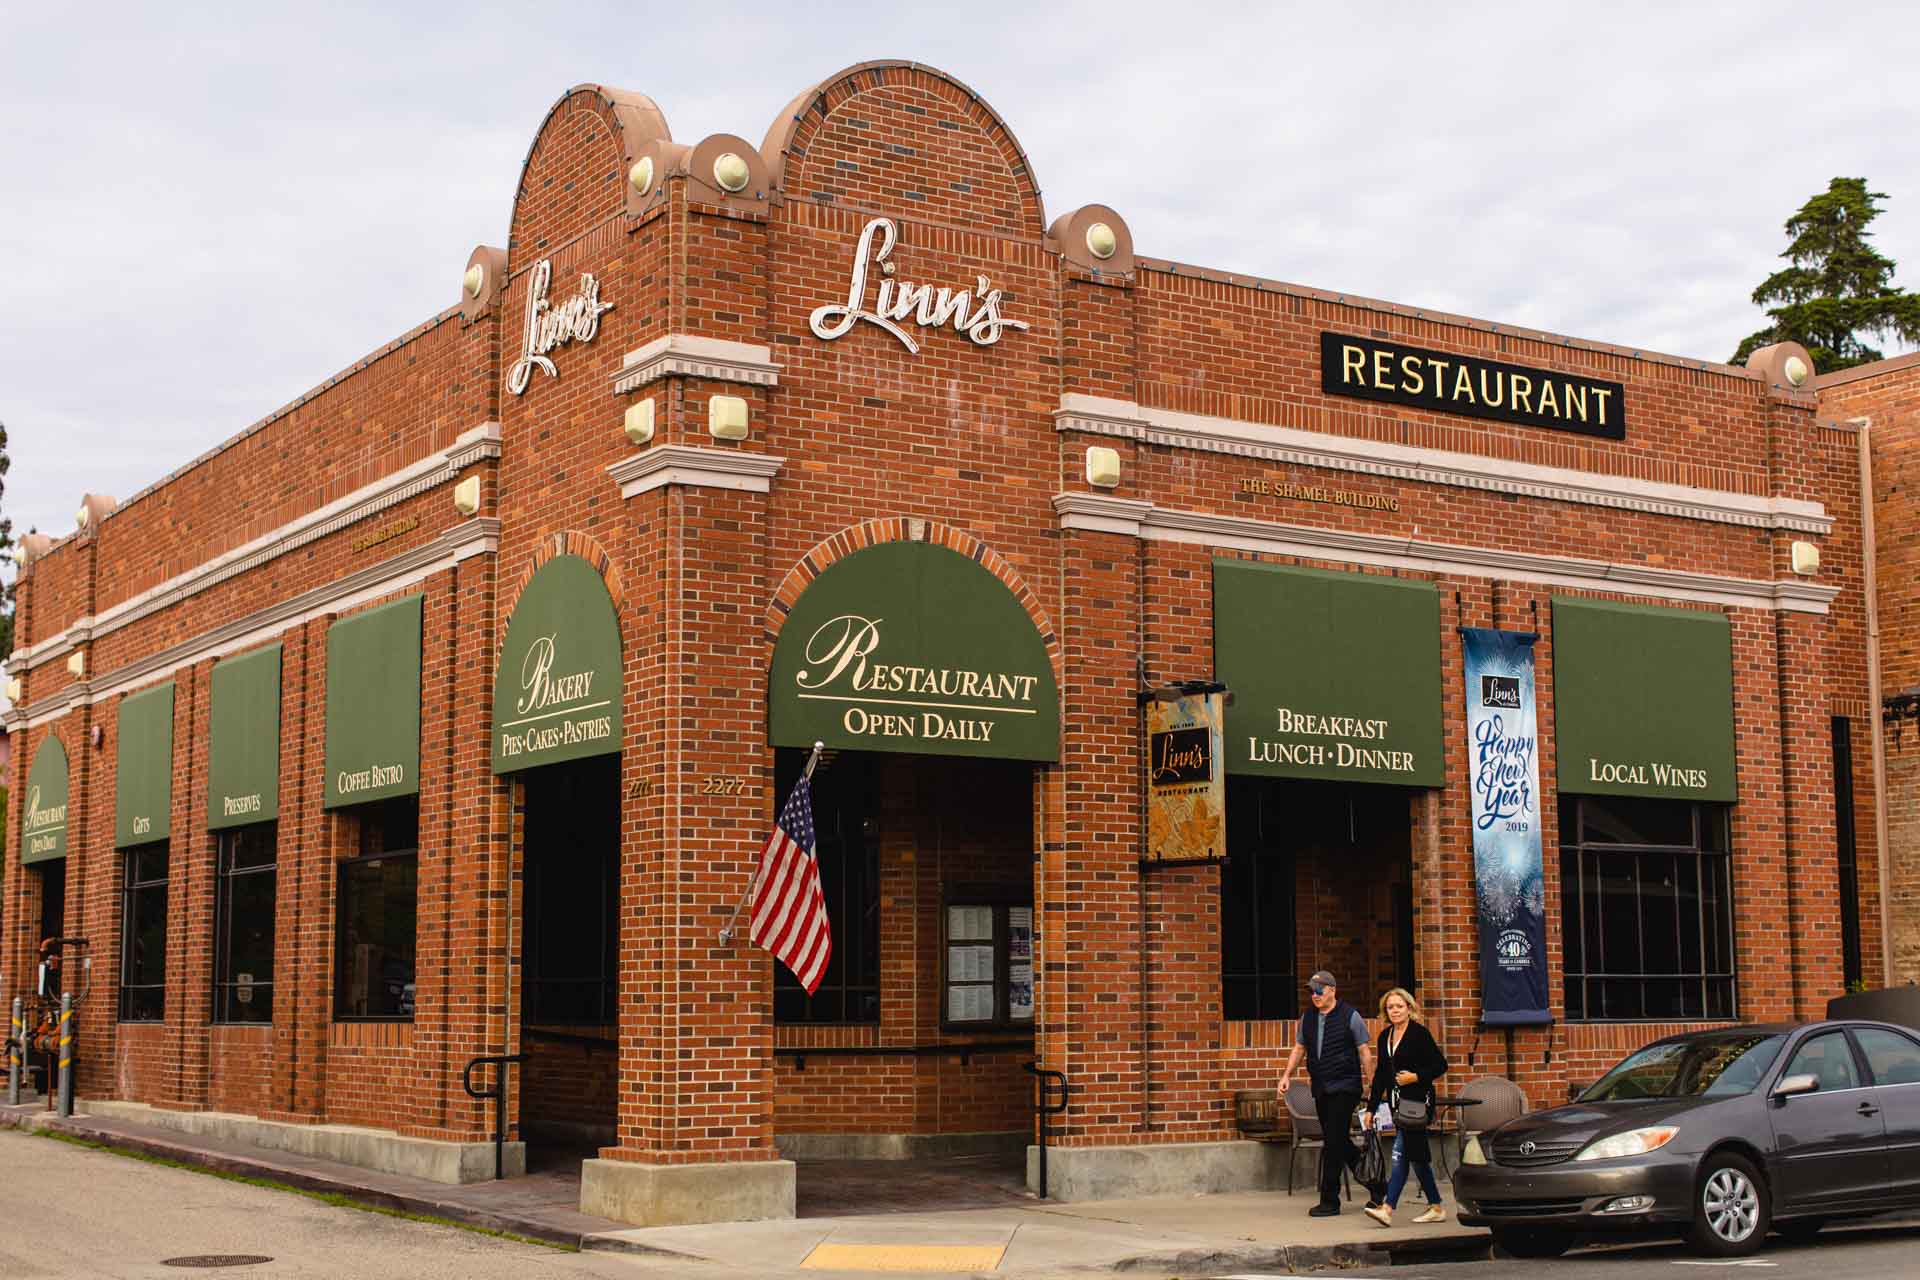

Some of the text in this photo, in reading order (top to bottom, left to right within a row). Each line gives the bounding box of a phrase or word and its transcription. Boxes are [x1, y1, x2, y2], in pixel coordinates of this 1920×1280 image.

[809, 217, 1030, 354] Linn's
[506, 258, 616, 395] Linn's
[1341, 343, 1612, 426] RESTAURANT
[1240, 479, 1400, 512] THE SHAMEL BUILDING
[517, 632, 595, 714] BAKERY
[796, 615, 1038, 701] RESTAURANT
[1483, 678, 1521, 706] Linn's
[843, 707, 995, 742] OPEN DAILY
[1277, 708, 1388, 740] BREAKFAST
[1475, 714, 1535, 766] Happy
[1153, 733, 1211, 780] Linn's
[1248, 737, 1415, 772] LUNCH DINNER
[1480, 753, 1528, 788] New
[338, 764, 403, 794] COFFEE BISTRO
[703, 778, 746, 795] 2277
[1590, 758, 1708, 788] LOCAL WINES
[224, 794, 261, 817] PRESERVES
[1476, 772, 1534, 831] Year
[133, 816, 150, 834] GIFTS
[1505, 821, 1529, 833] 2019
[1507, 941, 1520, 957] 40
